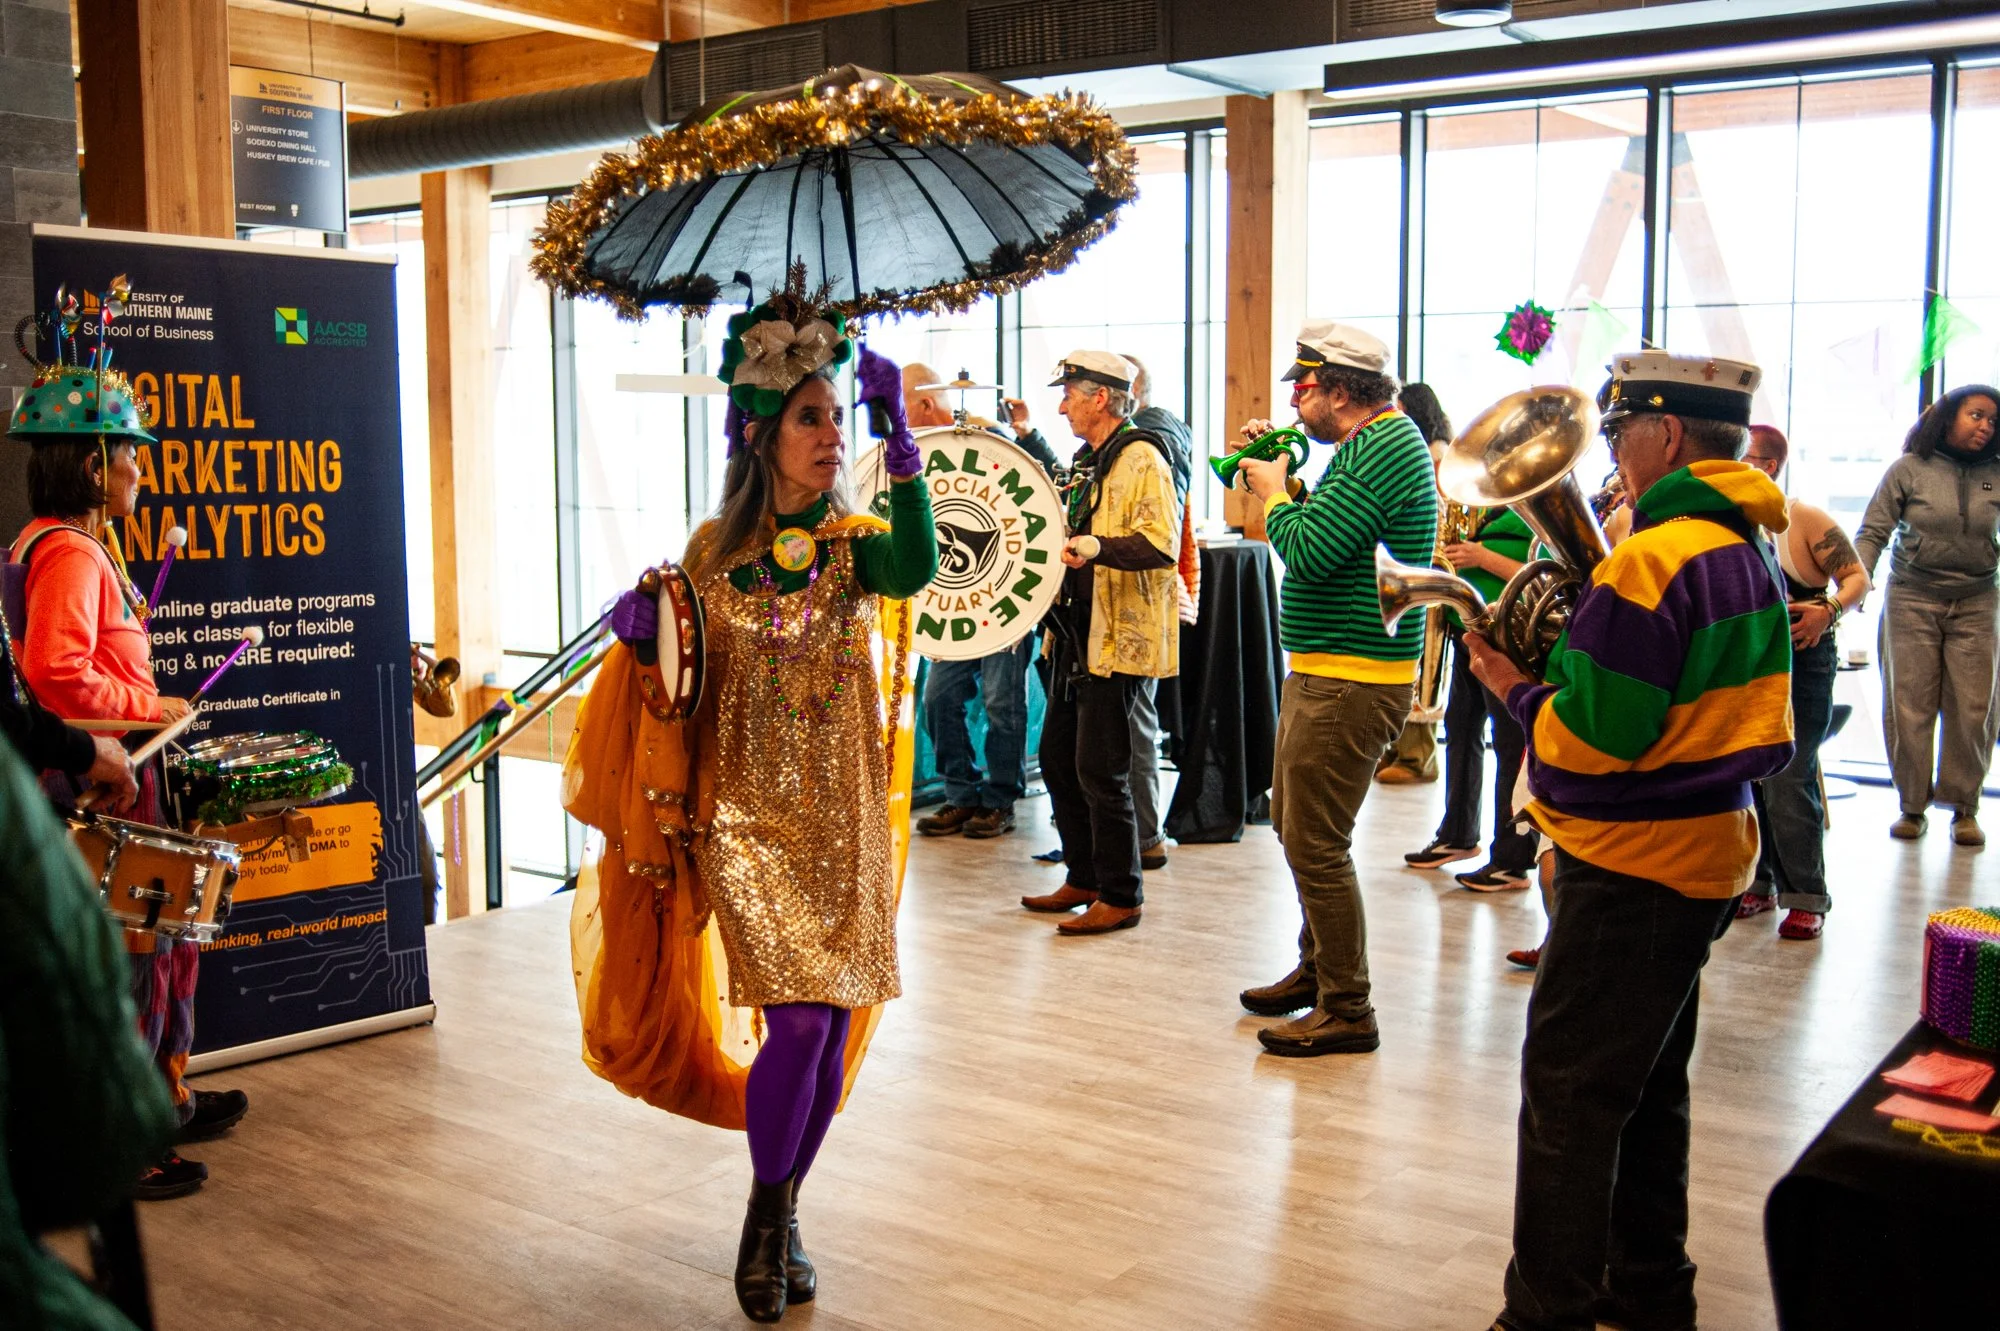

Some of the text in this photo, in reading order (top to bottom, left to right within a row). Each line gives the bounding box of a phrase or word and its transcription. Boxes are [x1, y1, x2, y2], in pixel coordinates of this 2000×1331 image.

[269, 89, 297, 98] SOUTHERN
[262, 105, 314, 120] FIRST FLOOR
[246, 124, 309, 139] UNIVERSITY STORE
[246, 138, 317, 153] SODEXO DINING HALL
[247, 151, 276, 161] HUSKEY
[277, 154, 297, 163] BREW
[297, 156, 314, 166] CAFE
[318, 159, 331, 168] PUB
[255, 204, 276, 212] ROOMS
[131, 292, 185, 304] ERSITY OF
[122, 304, 213, 321] UTHERN MAINE
[136, 323, 150, 338] of
[154, 325, 214, 341] Business
[313, 320, 368, 338] AACSB
[313, 337, 368, 347] ACCREDITED
[122, 371, 256, 429] GITAL
[135, 440, 343, 495] ARKETING
[929, 476, 1022, 555] OCIAL AID
[989, 468, 1048, 628] MAINE
[210, 596, 293, 619] graduate
[297, 593, 376, 614] programs
[914, 582, 994, 612] TUARY
[150, 617, 354, 645] eek class for flexible
[916, 611, 977, 642] ND
[184, 652, 198, 670] &
[202, 654, 227, 669] no
[233, 646, 272, 667] GRE
[277, 641, 355, 665] required:
[198, 696, 260, 712] Graduate
[262, 689, 328, 707] Certificate
[330, 688, 341, 700] in
[185, 719, 212, 735] year
[324, 826, 335, 836] or
[337, 824, 352, 836] go
[340, 838, 350, 848] to
[240, 862, 292, 881] ply today.
[267, 916, 339, 941] real-world
[341, 908, 388, 928] impact
